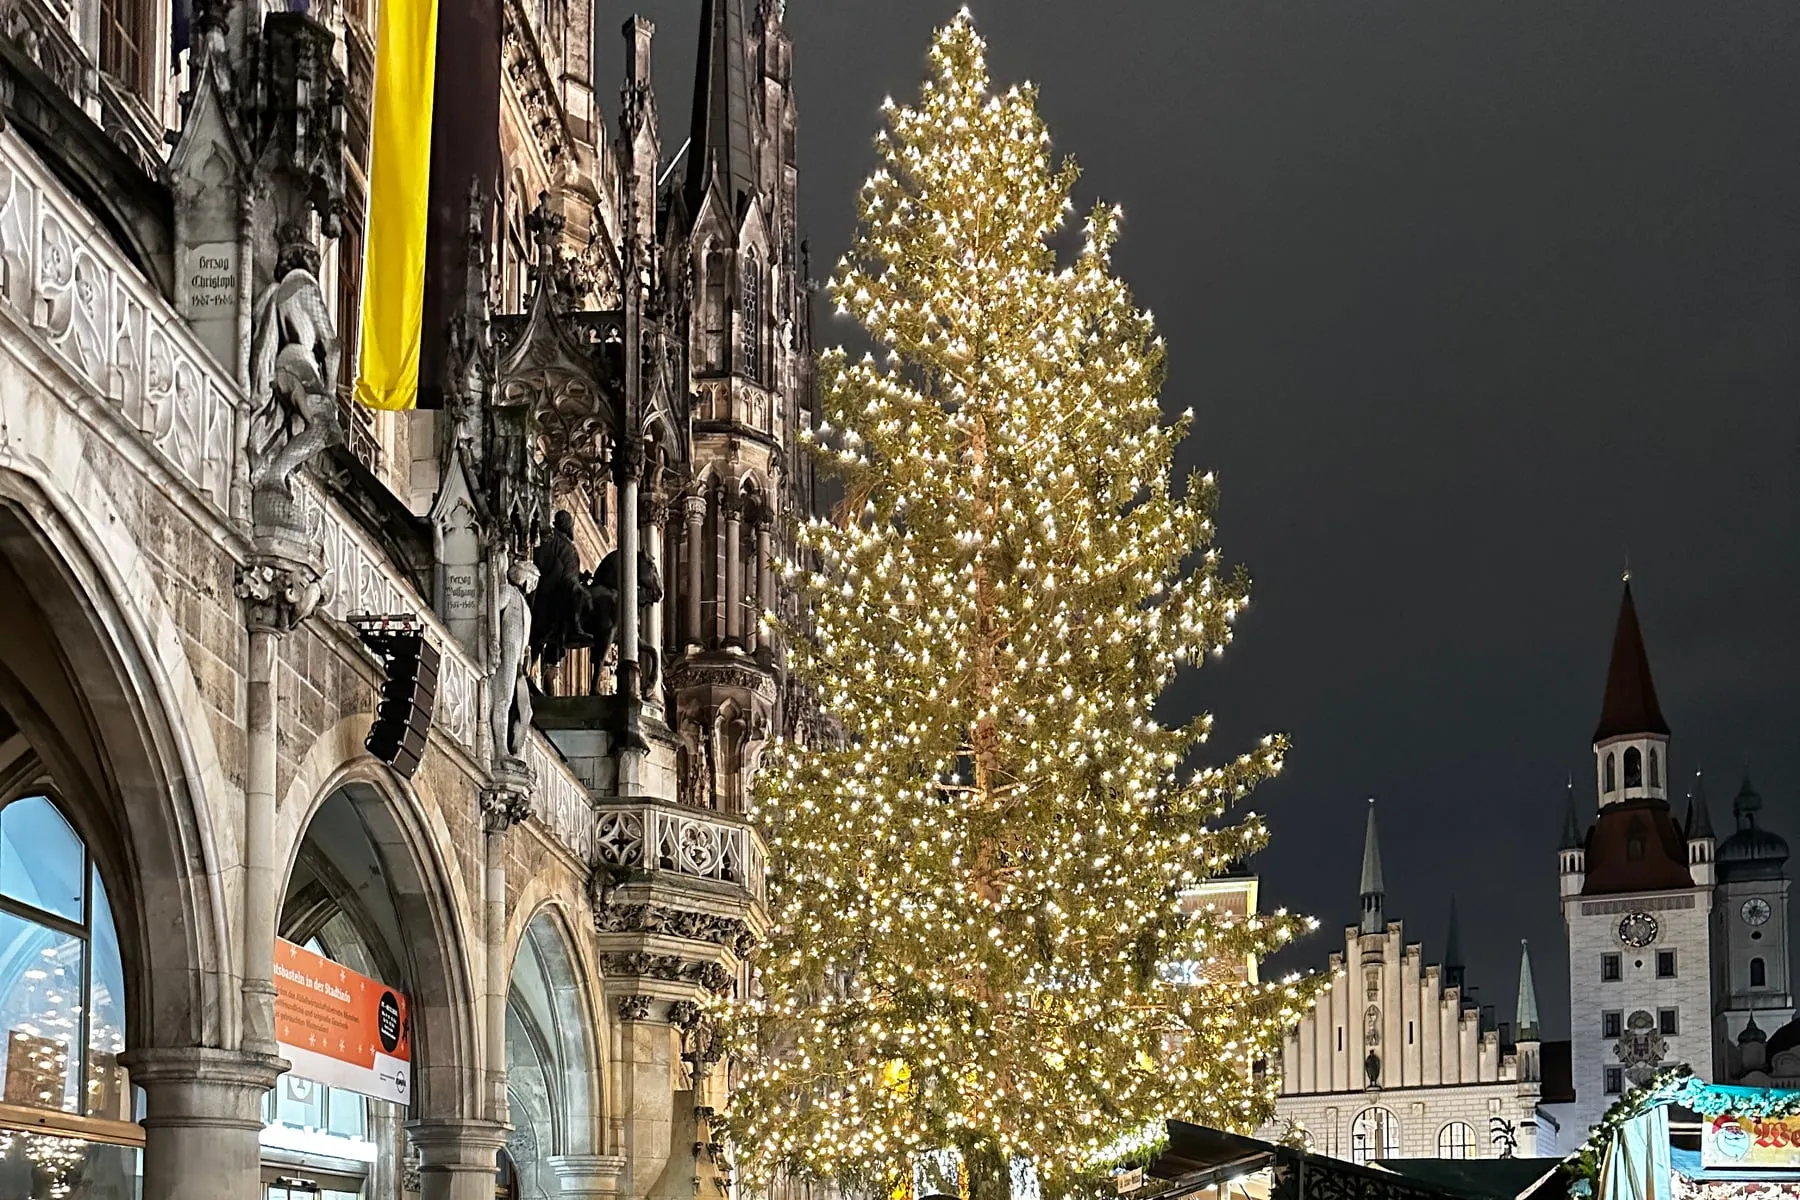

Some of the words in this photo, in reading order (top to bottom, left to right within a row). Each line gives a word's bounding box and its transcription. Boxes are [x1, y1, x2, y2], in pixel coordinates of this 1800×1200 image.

[199, 255, 229, 272] Herzog
[191, 274, 235, 290] Christoph
[305, 976, 314, 989] in
[314, 977, 324, 993] der
[324, 982, 351, 1003] Stadtinfo
